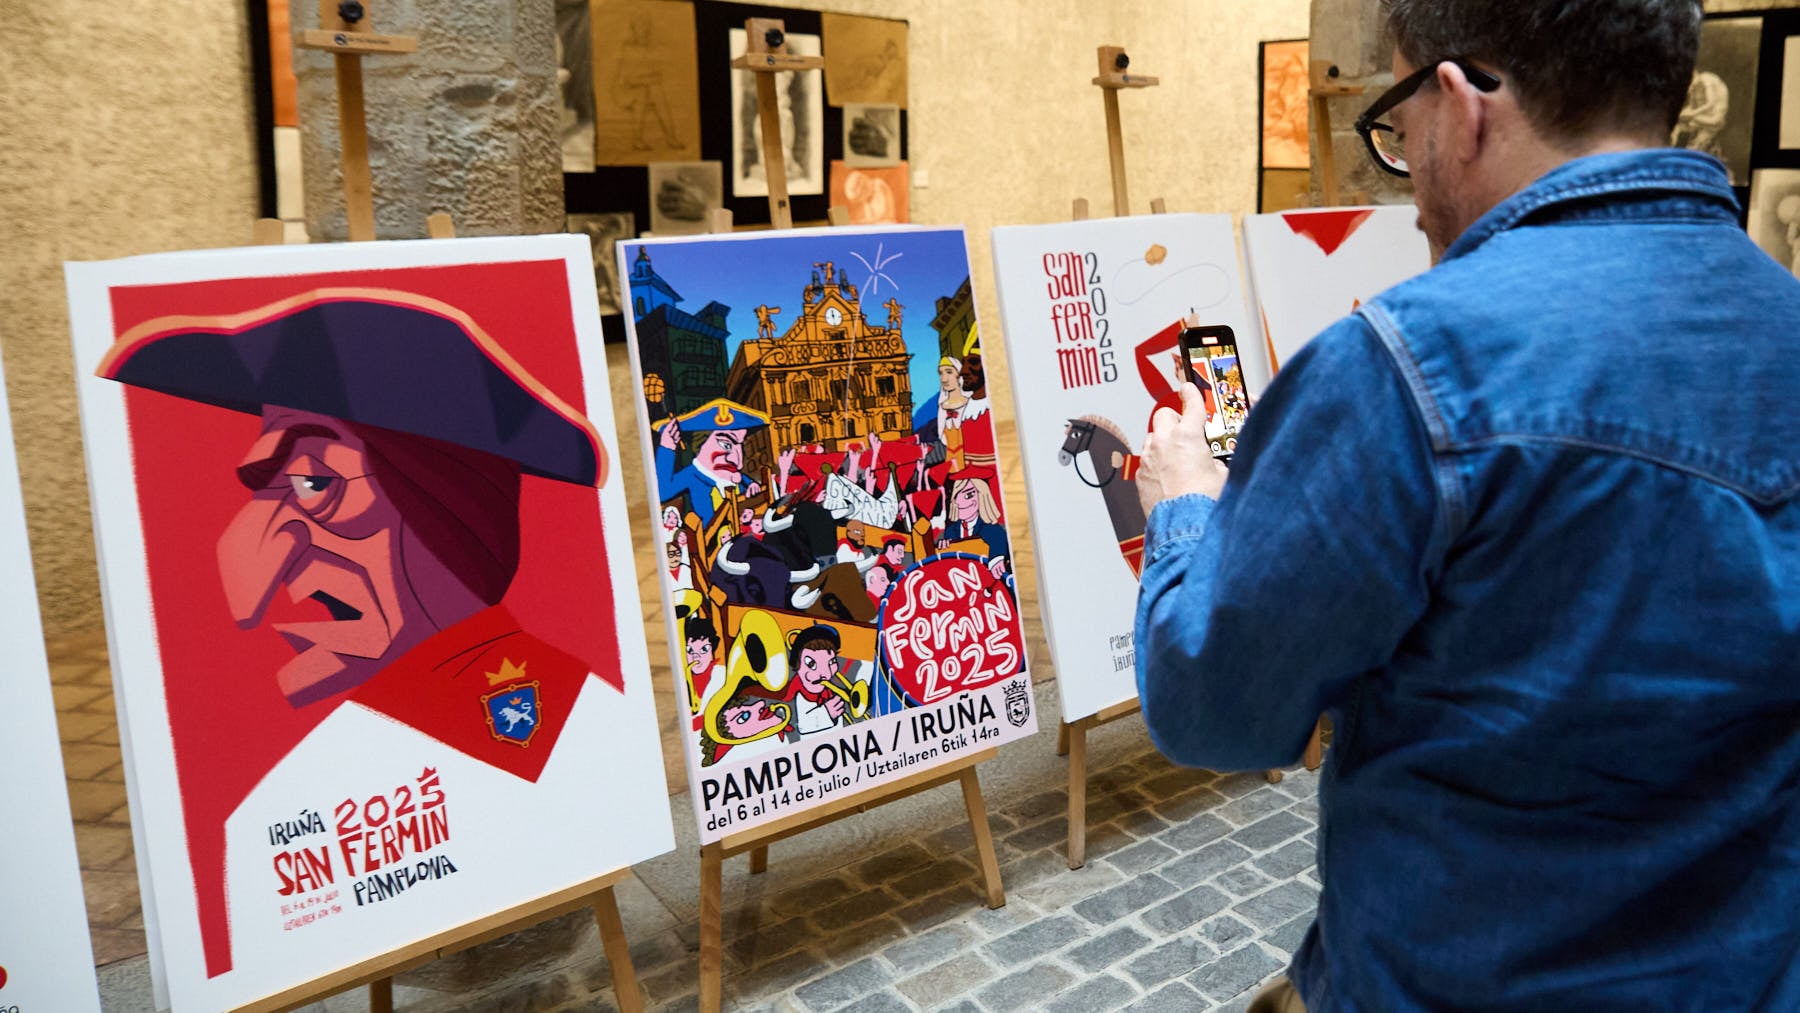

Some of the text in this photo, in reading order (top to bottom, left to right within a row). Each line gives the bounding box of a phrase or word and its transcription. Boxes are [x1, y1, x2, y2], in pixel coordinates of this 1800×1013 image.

[1056, 343, 1102, 390] min
[915, 628, 1018, 703] 2025
[701, 692, 996, 811] PAMPLONA / IRUÑA
[707, 725, 1000, 831] del 6 al 14 de julio / Uztailaren 6tik 14ra
[268, 774, 446, 846] IRUÑA 2025
[273, 804, 450, 896] SAN FERMIN
[352, 854, 459, 907] PAMPLONA
